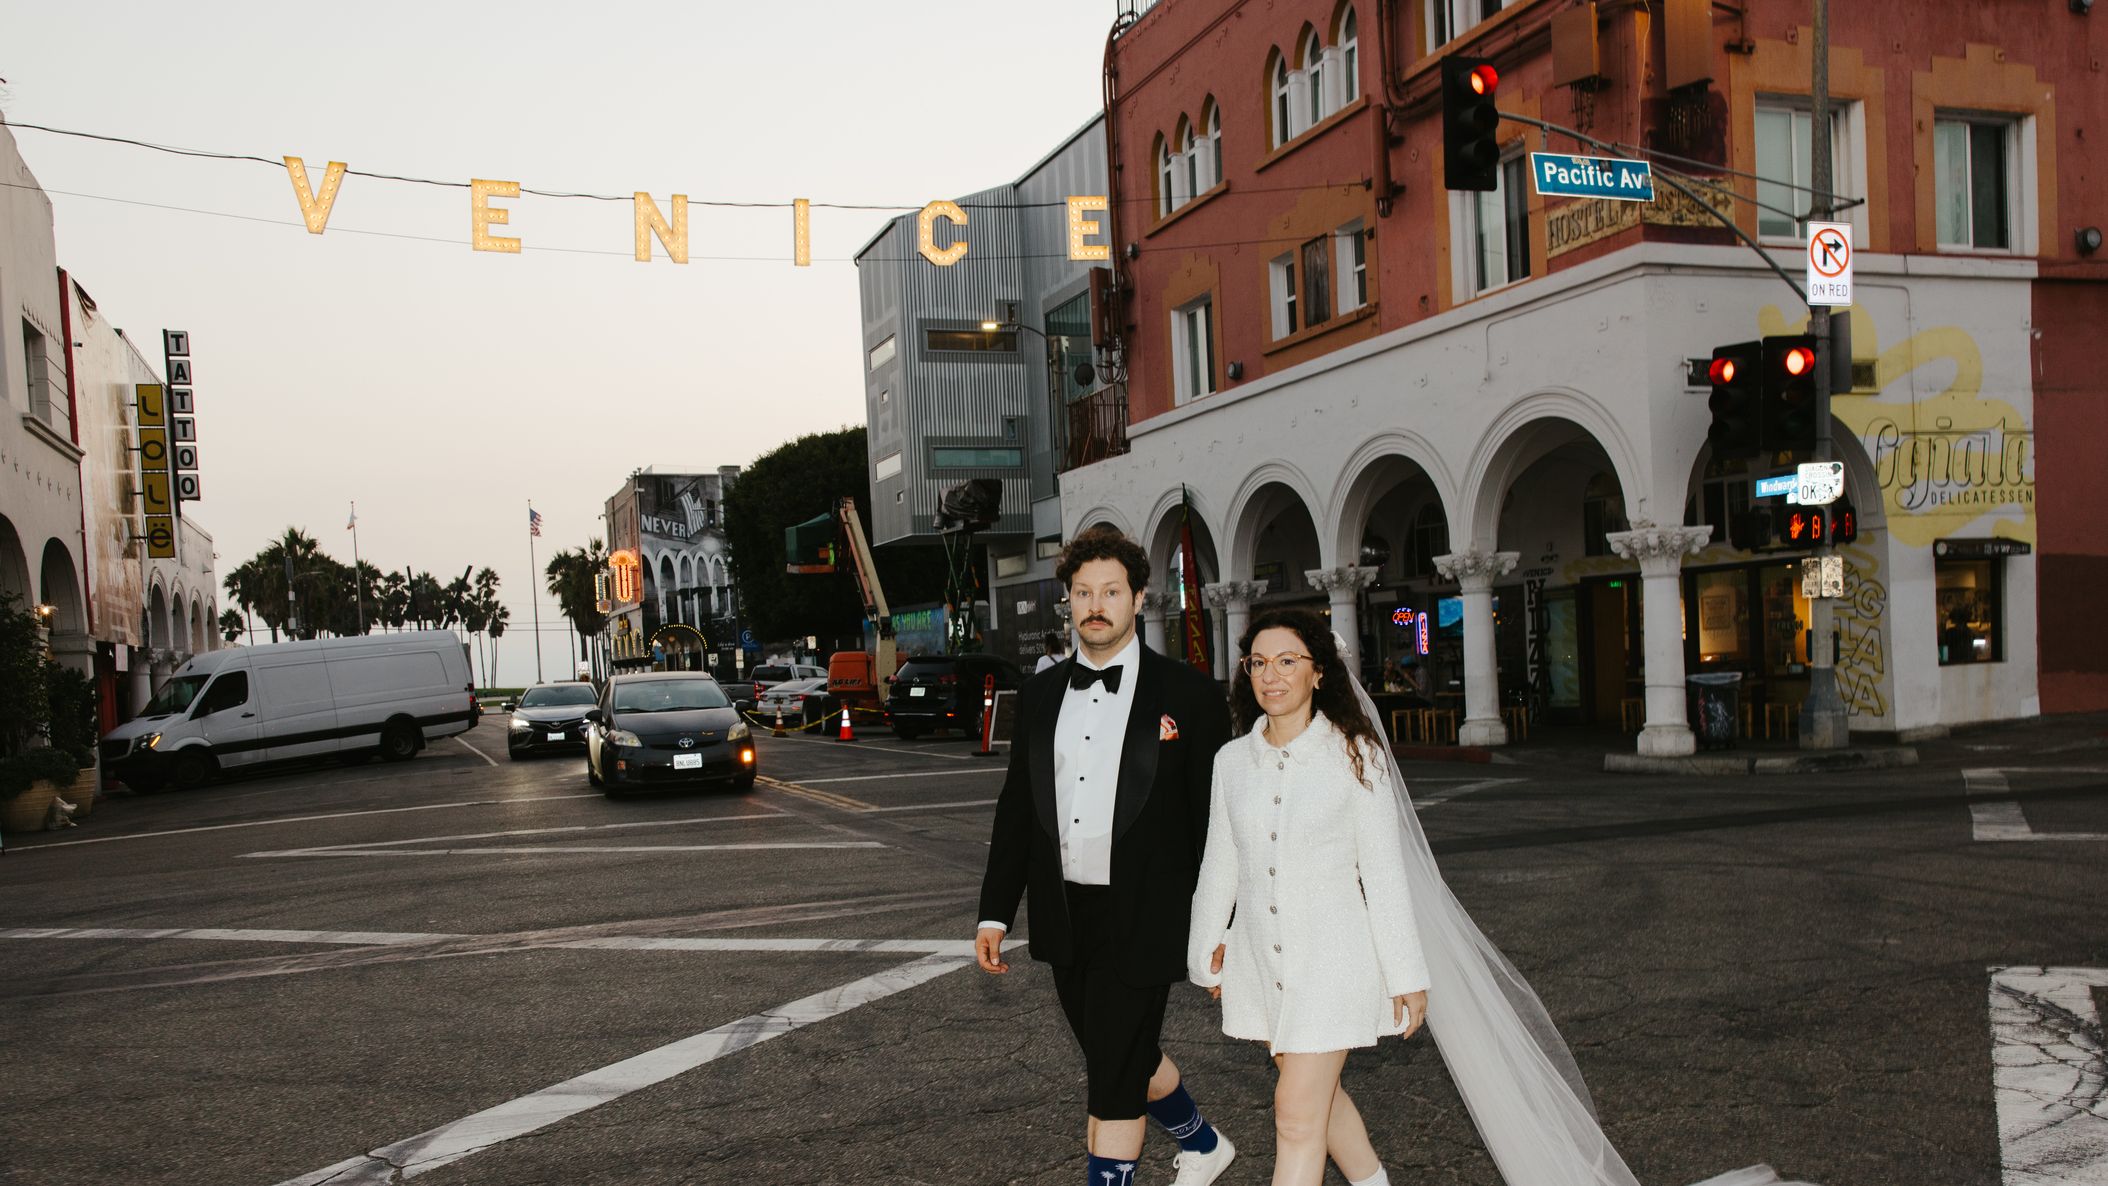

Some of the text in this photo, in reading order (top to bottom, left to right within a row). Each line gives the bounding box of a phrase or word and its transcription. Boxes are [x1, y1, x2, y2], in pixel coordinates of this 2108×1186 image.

[1544, 162, 1614, 187] Pacific
[283, 156, 1110, 267] VENICE
[1548, 199, 1620, 250] HOSTEL
[1812, 283, 1848, 297] ON RED
[170, 333, 196, 495] TATTOO
[1802, 484, 1817, 500] OK
[1930, 489, 2033, 505] DELICATESSEN
[641, 514, 687, 538] NEVER
[1392, 612, 1415, 623] OPEN
[1420, 614, 1429, 653] PIZZA
